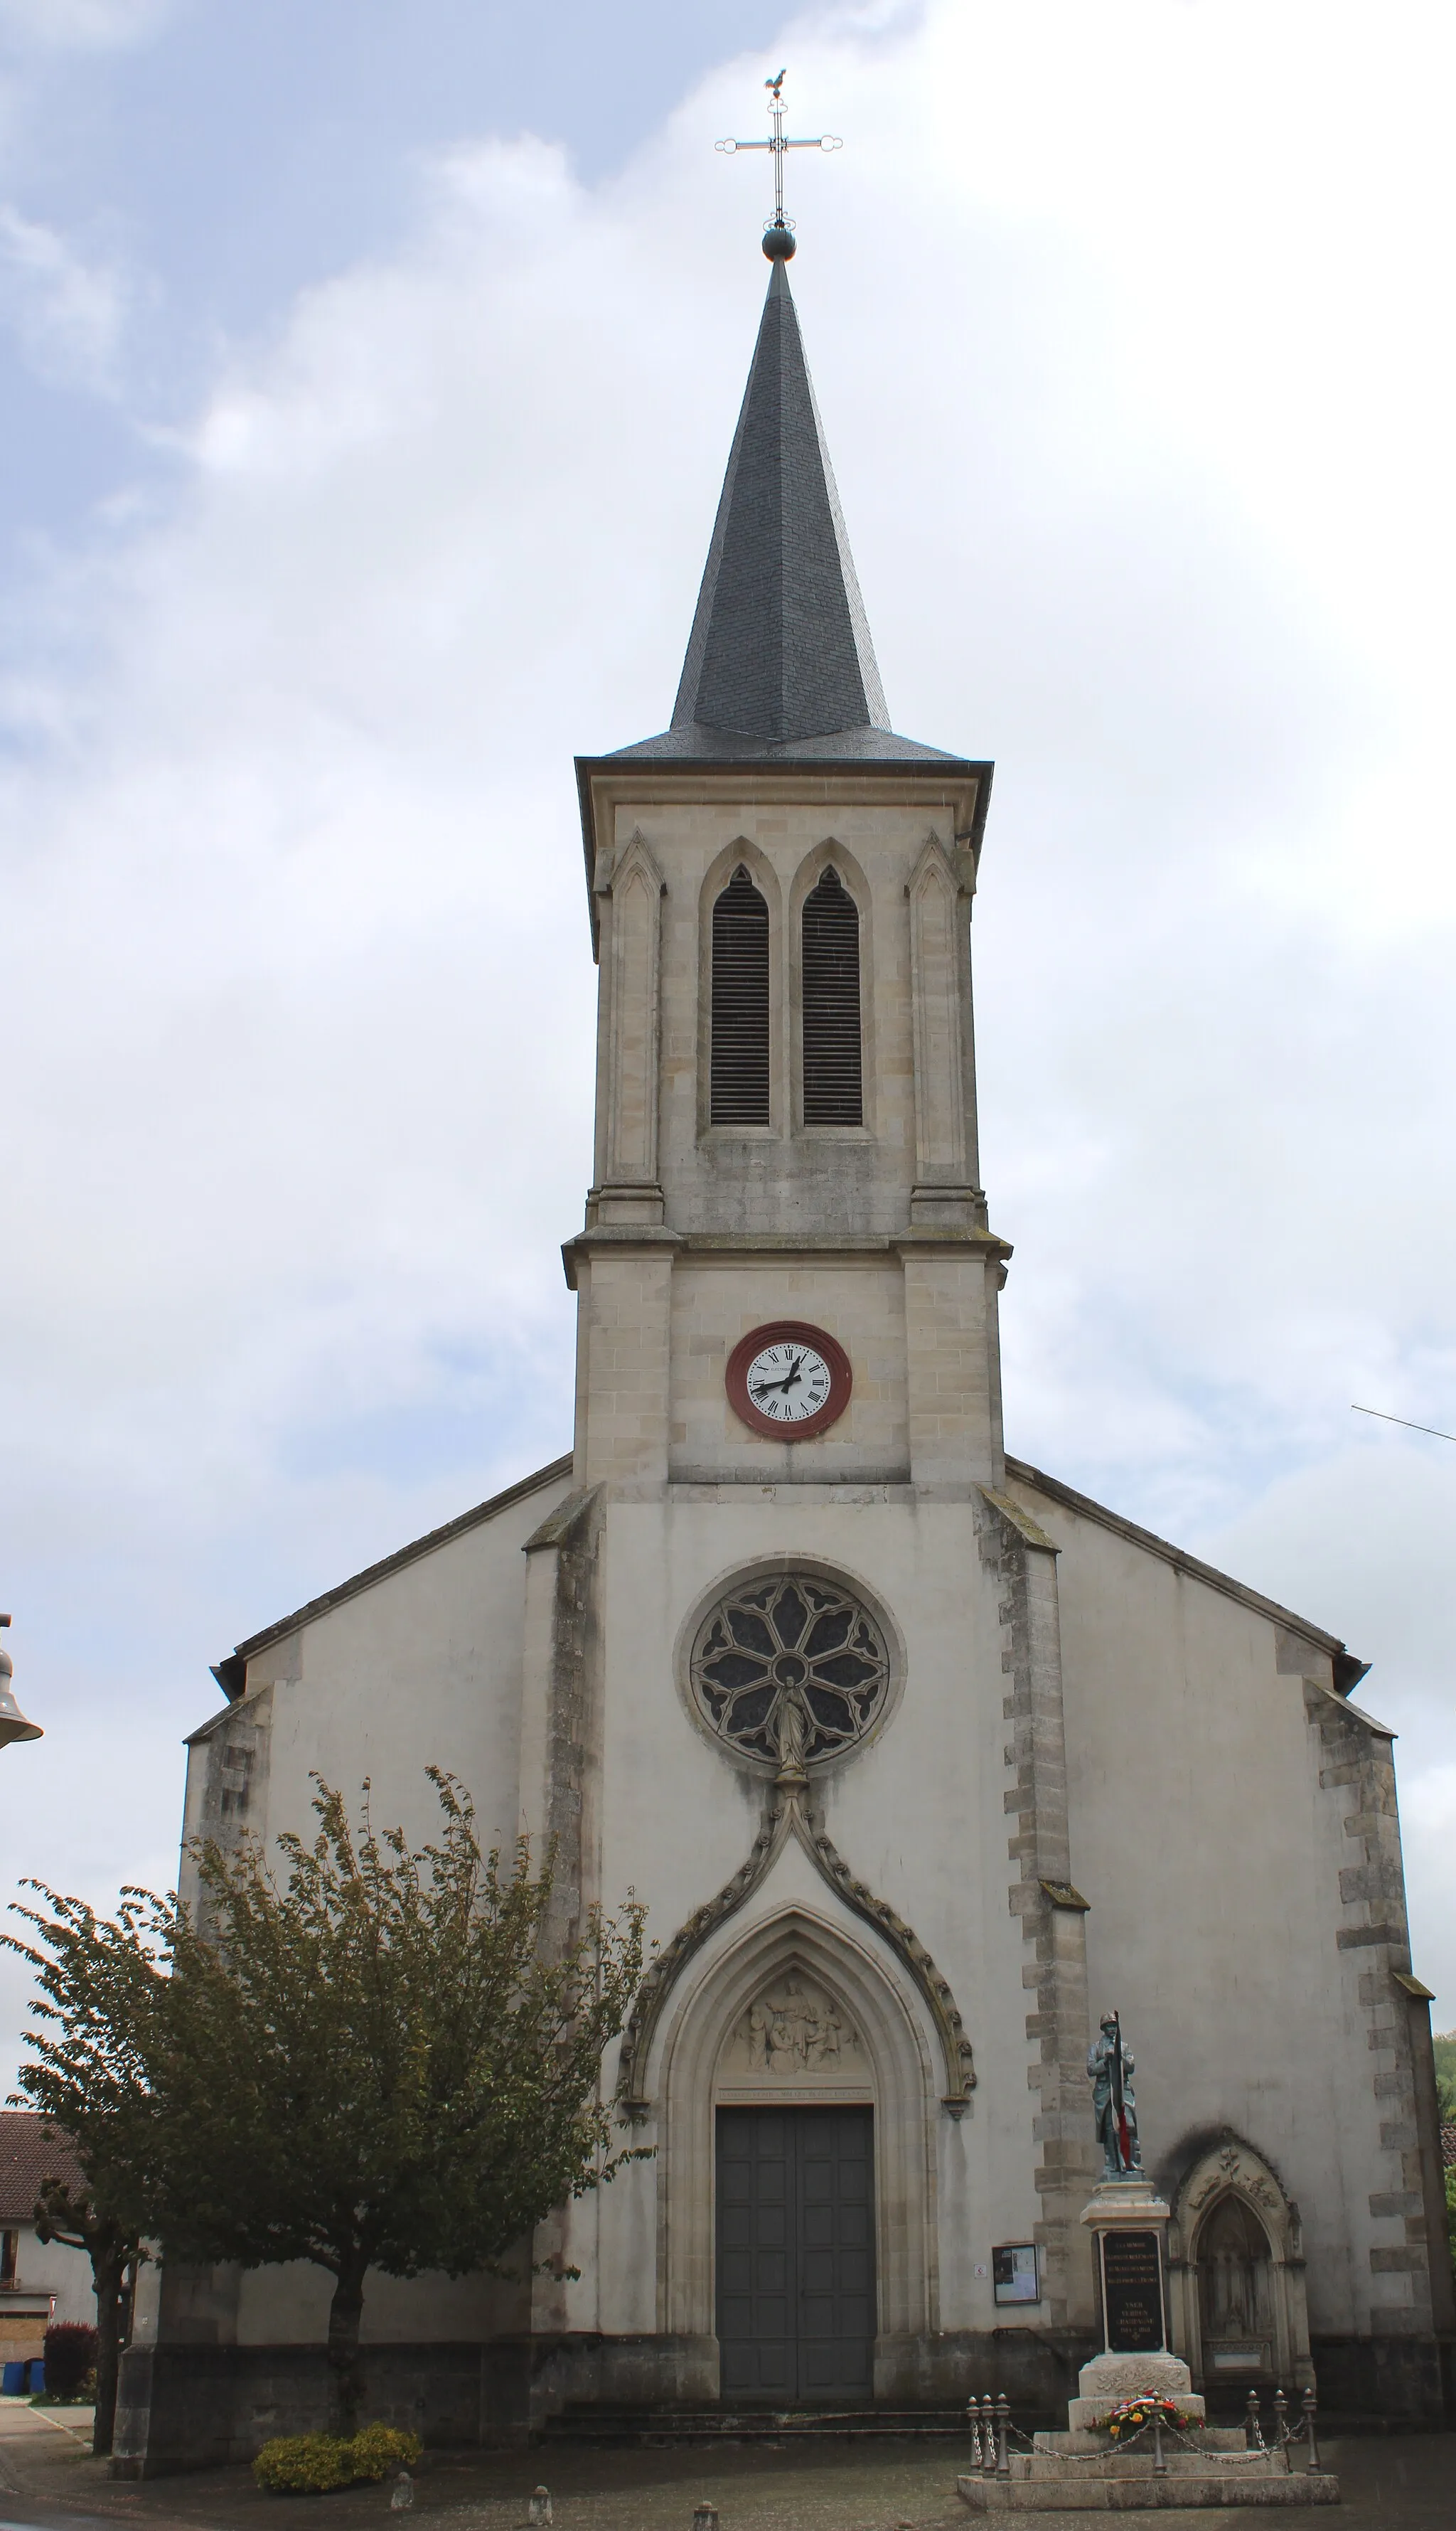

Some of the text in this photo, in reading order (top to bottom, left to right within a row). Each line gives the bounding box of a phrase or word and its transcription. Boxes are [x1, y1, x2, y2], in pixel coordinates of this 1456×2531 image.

[768, 1353, 779, 1364] XI
[784, 1349, 793, 1360] XII
[756, 1364, 769, 1373] X
[808, 1364, 820, 1373] II
[767, 1400, 779, 1414] VII
[784, 1405, 792, 1417] VI
[800, 1402, 808, 1412] V
